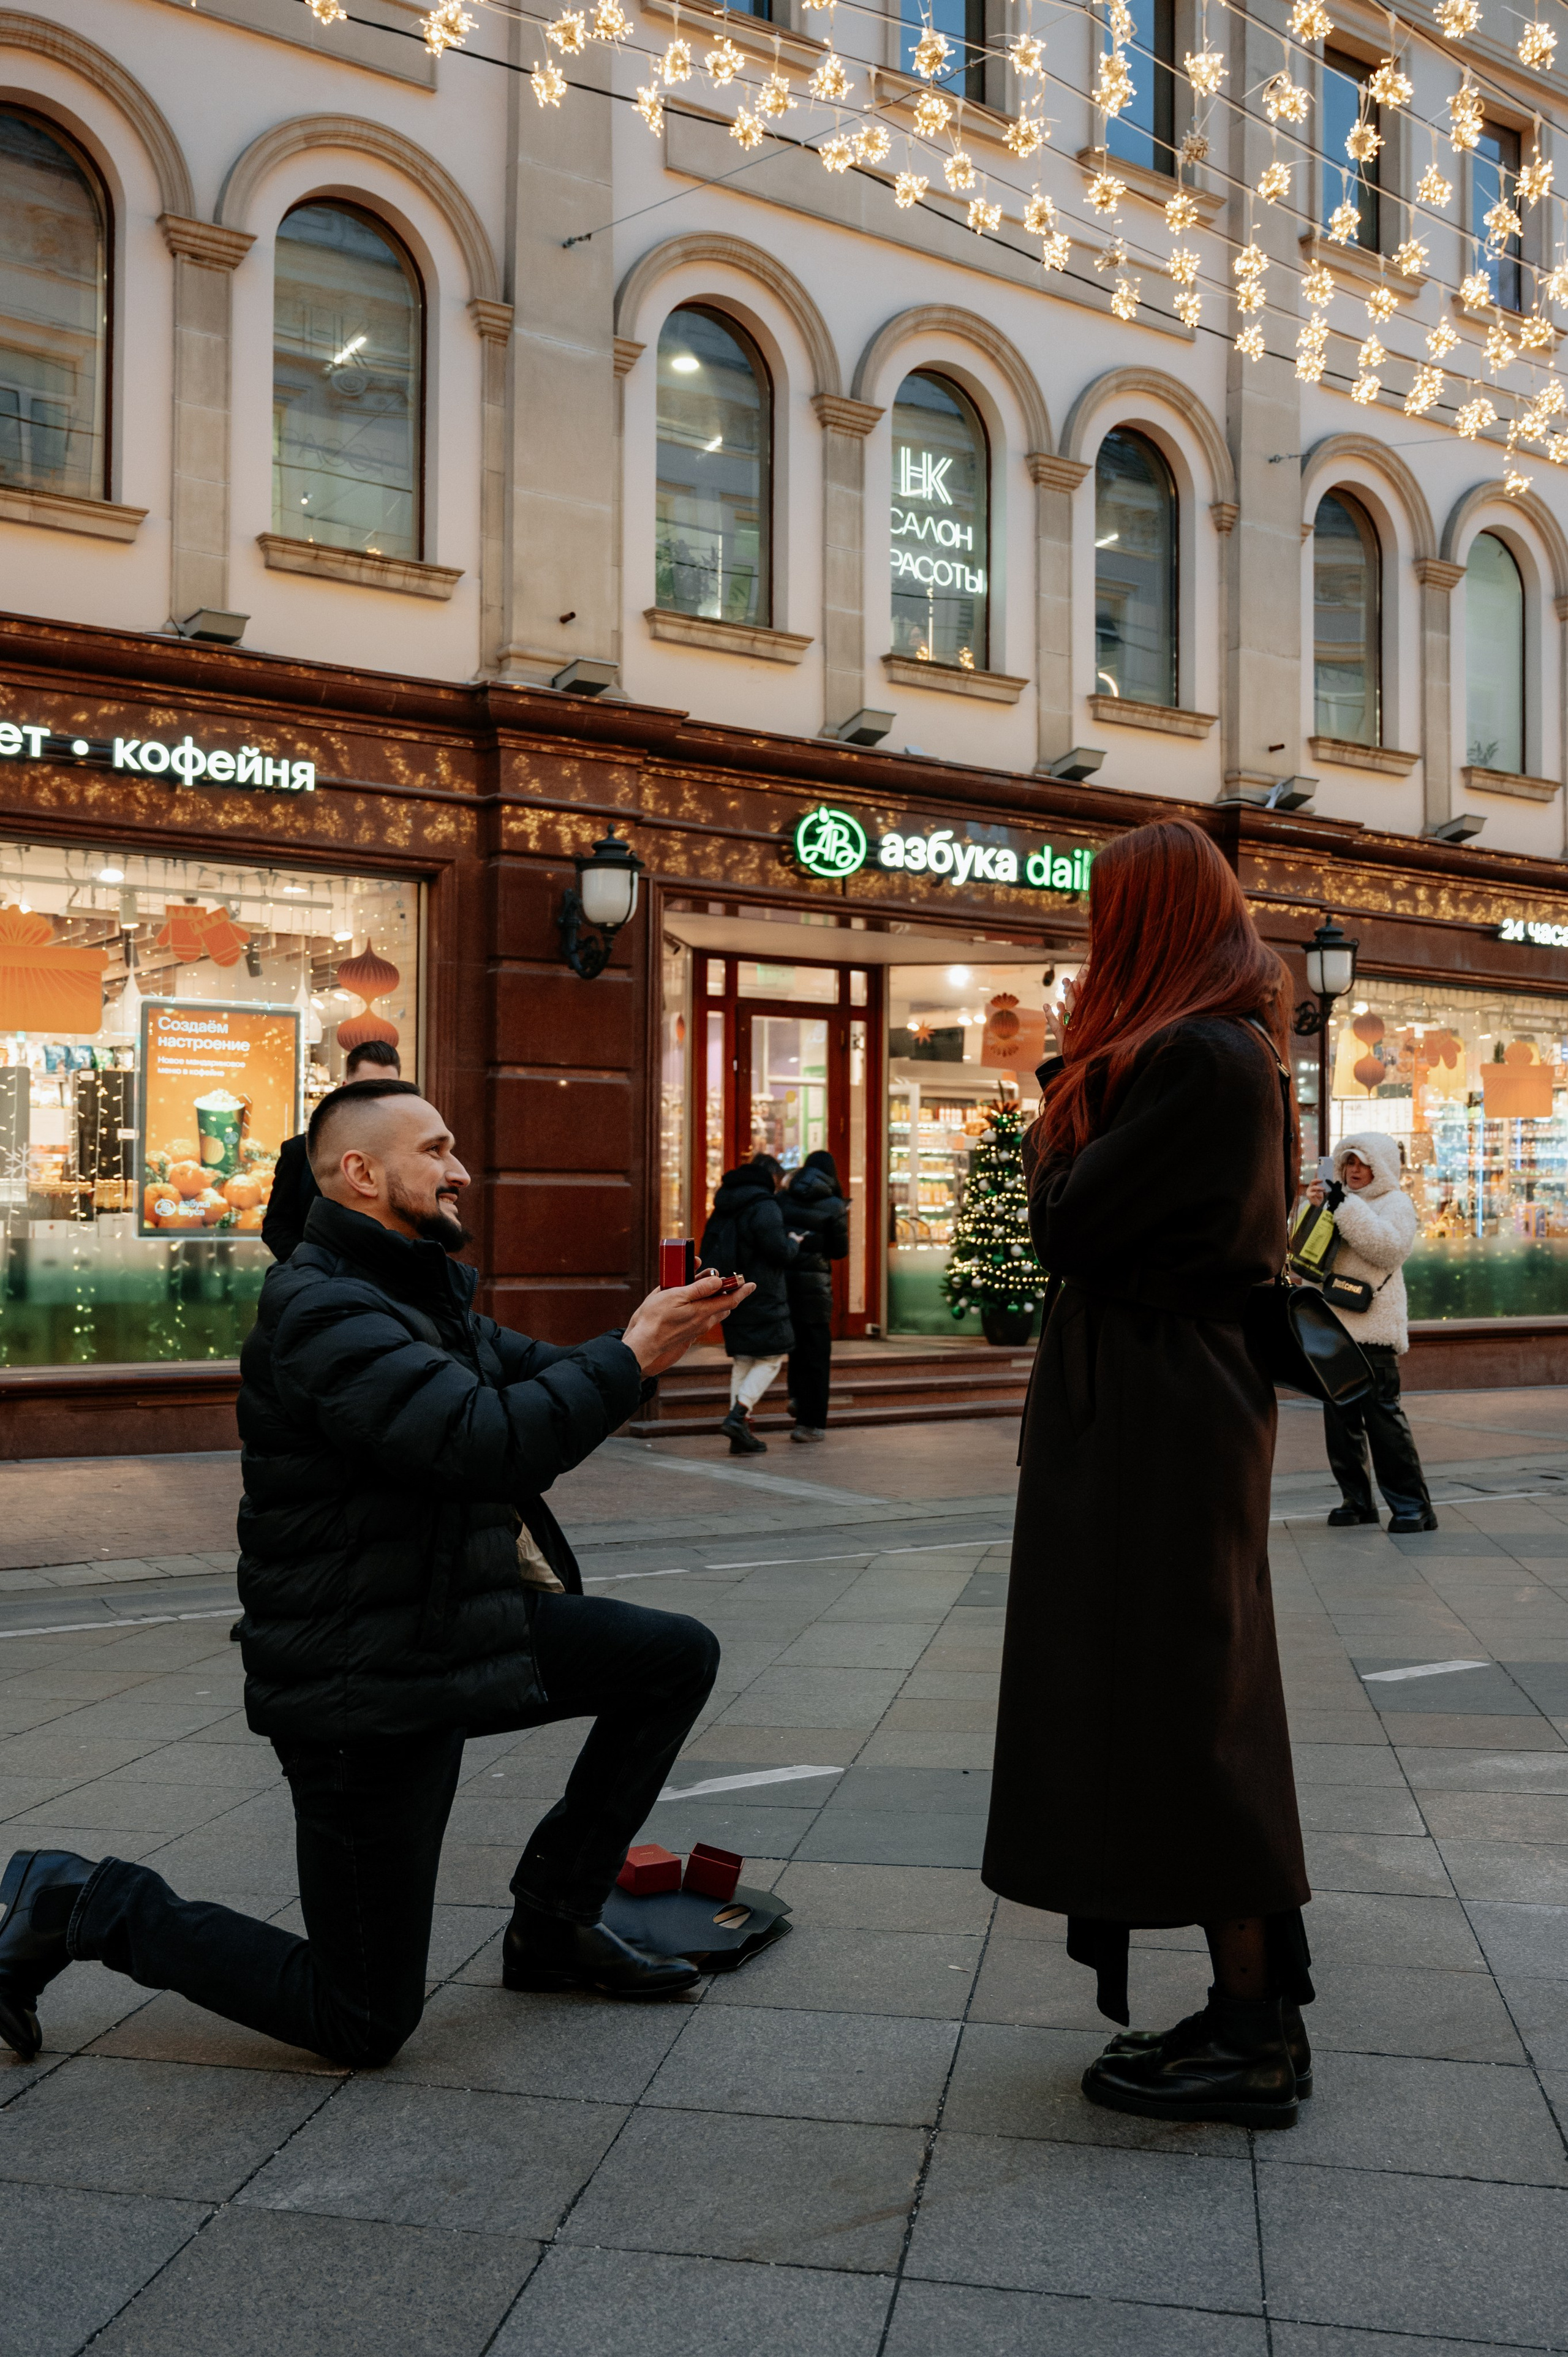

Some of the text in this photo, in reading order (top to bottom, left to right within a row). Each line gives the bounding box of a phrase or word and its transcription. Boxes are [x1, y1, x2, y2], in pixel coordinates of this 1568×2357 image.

[889, 507, 973, 551] САЛОН
[0, 722, 315, 791] ет кофейня
[880, 829, 1018, 886] азбука
[1501, 918, 1525, 941] 24
[157, 1016, 228, 1034] Создаём
[157, 1036, 251, 1052] настроение
[157, 1056, 185, 1065] Новое
